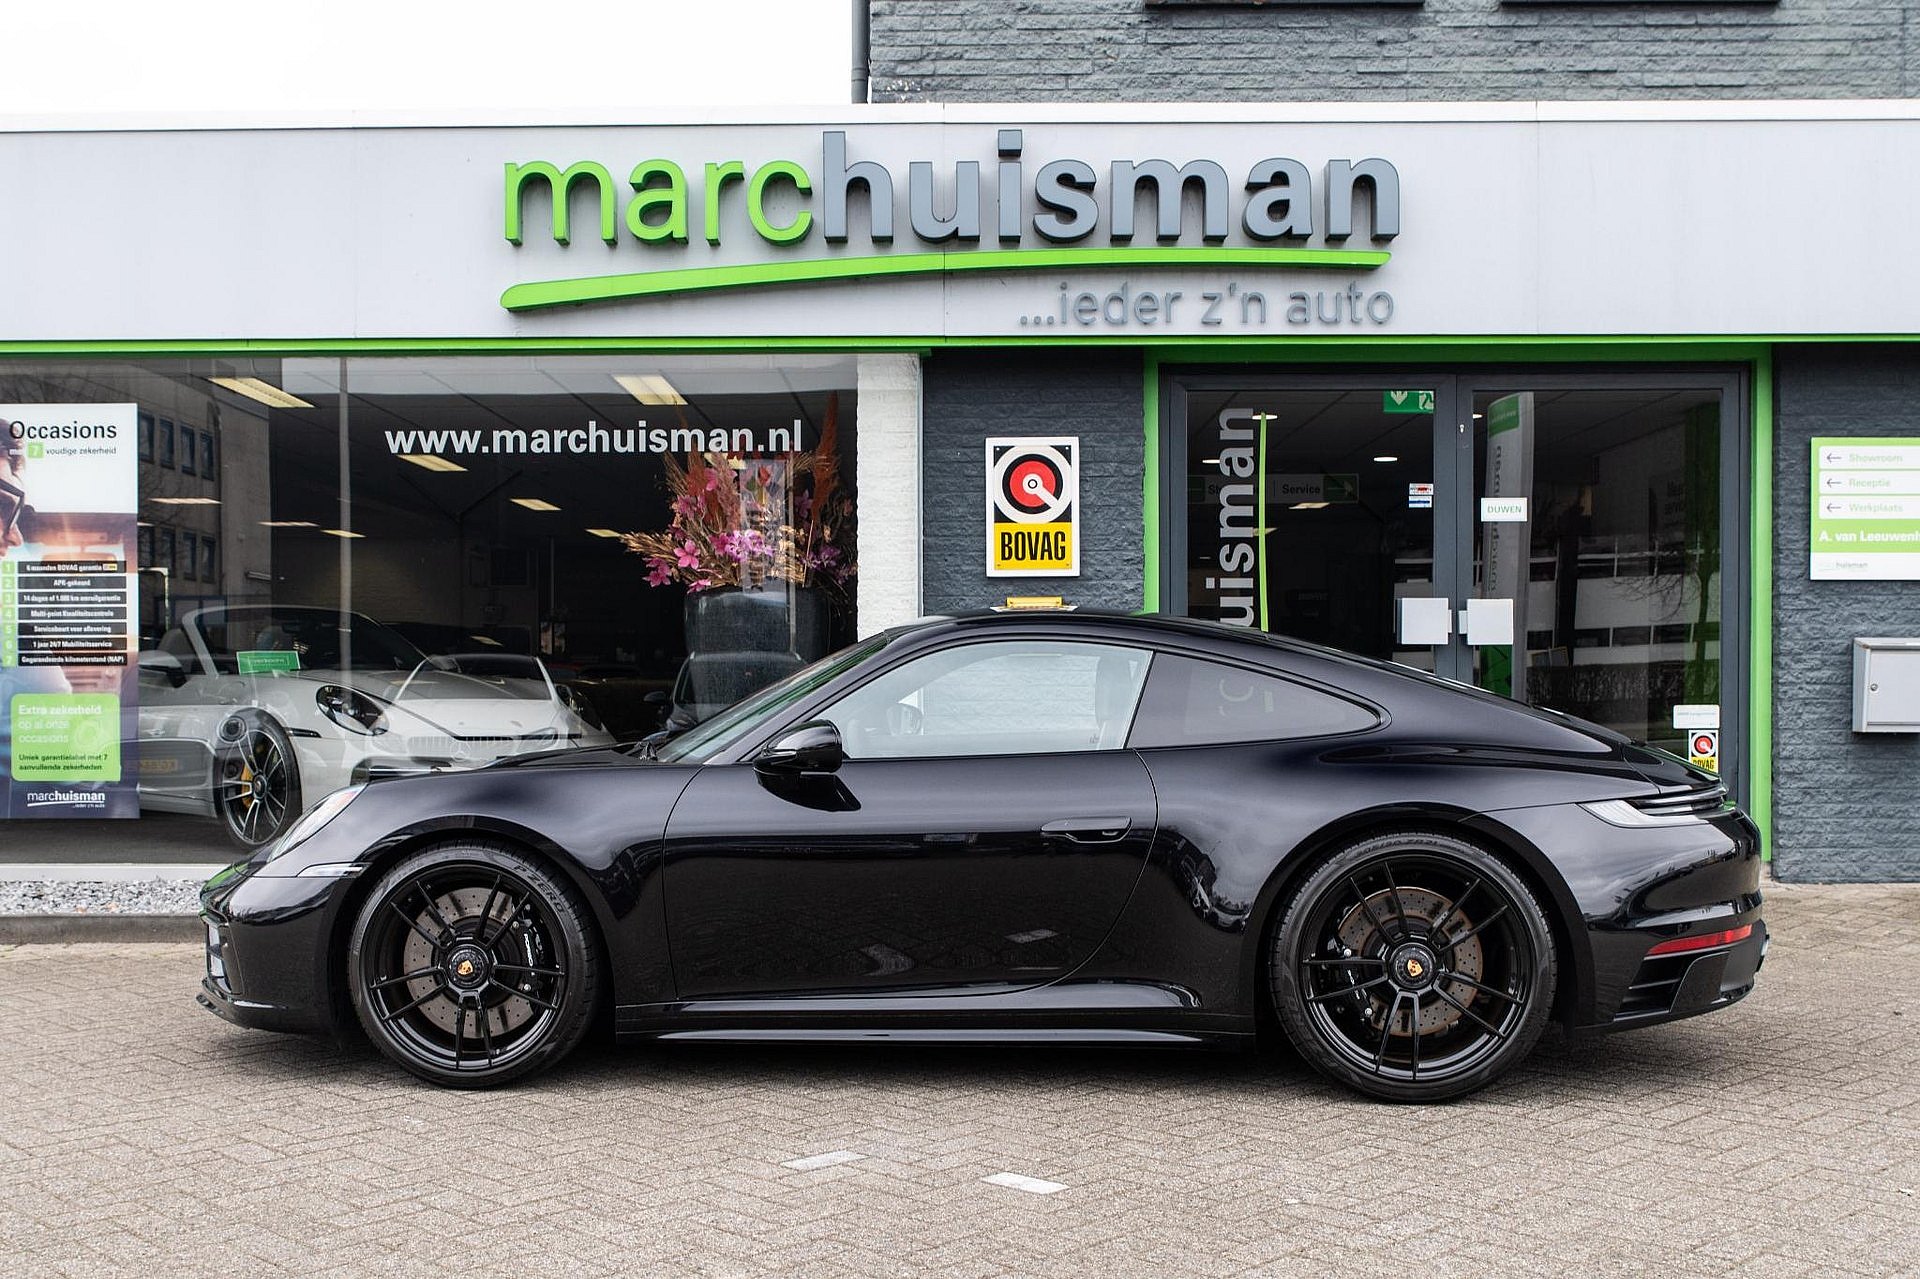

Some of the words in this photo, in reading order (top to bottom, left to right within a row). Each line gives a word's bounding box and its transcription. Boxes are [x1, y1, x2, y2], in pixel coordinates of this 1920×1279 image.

[504, 129, 1400, 246] marchuisman
[1020, 281, 1183, 325] ...ieder
[1200, 282, 1267, 325] z'n
[1286, 281, 1395, 325] auto
[9, 420, 117, 439] Occasions
[384, 419, 802, 454] www.marchuisman.nl
[46, 447, 77, 455] voudige
[1849, 453, 1903, 462] Showroom
[1849, 478, 1890, 488] Receptie
[1282, 484, 1320, 495] Service
[1849, 503, 1904, 512] Werkplaats
[1835, 533, 1857, 541] van
[1001, 531, 1066, 561] BOVAG
[18, 705, 48, 715] Extra
[50, 705, 102, 715] zekerheid
[27, 790, 106, 801] marchuisman
